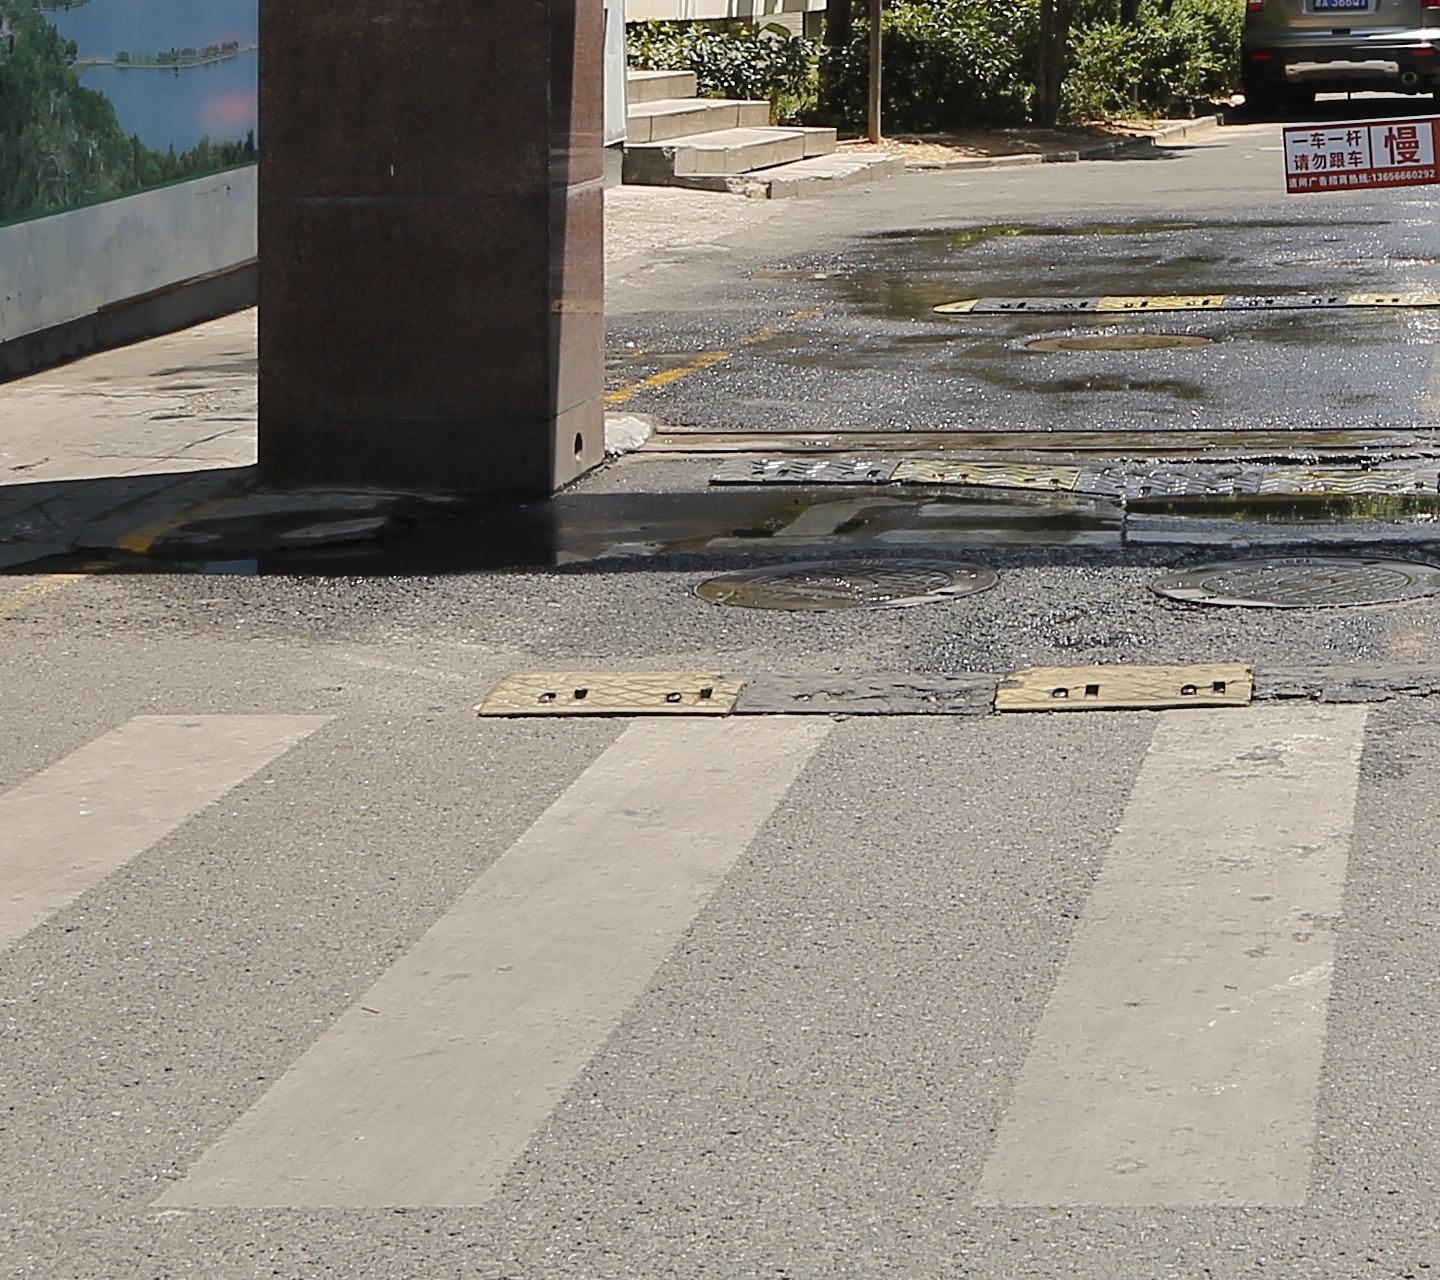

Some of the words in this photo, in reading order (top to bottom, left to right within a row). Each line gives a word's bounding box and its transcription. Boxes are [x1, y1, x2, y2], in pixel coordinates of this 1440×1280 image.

[1292, 130, 1362, 149] 一车一杆
[1384, 126, 1421, 165] 慢
[1293, 151, 1363, 171] 请勿跟车
